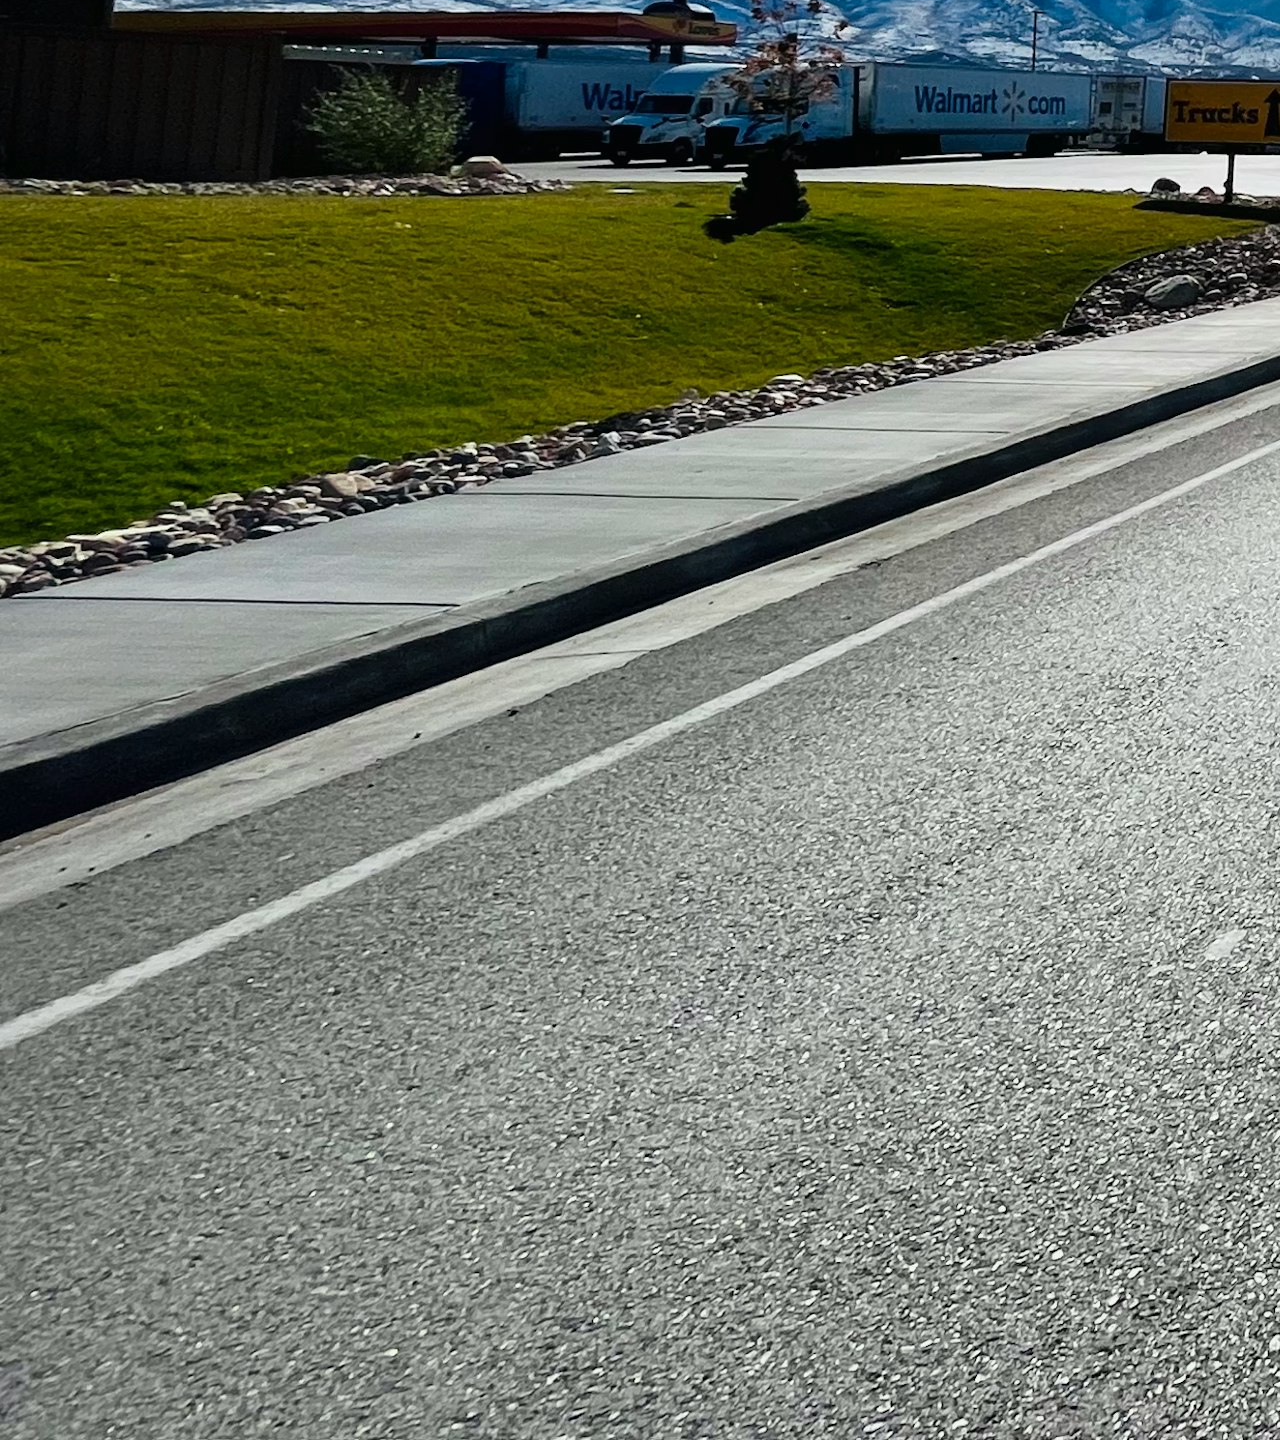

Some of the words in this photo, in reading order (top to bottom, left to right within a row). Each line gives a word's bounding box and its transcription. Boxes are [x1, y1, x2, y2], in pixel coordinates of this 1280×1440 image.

[914, 85, 998, 114] Walmart
[1028, 95, 1066, 115] com
[1172, 100, 1259, 124] Trucks
